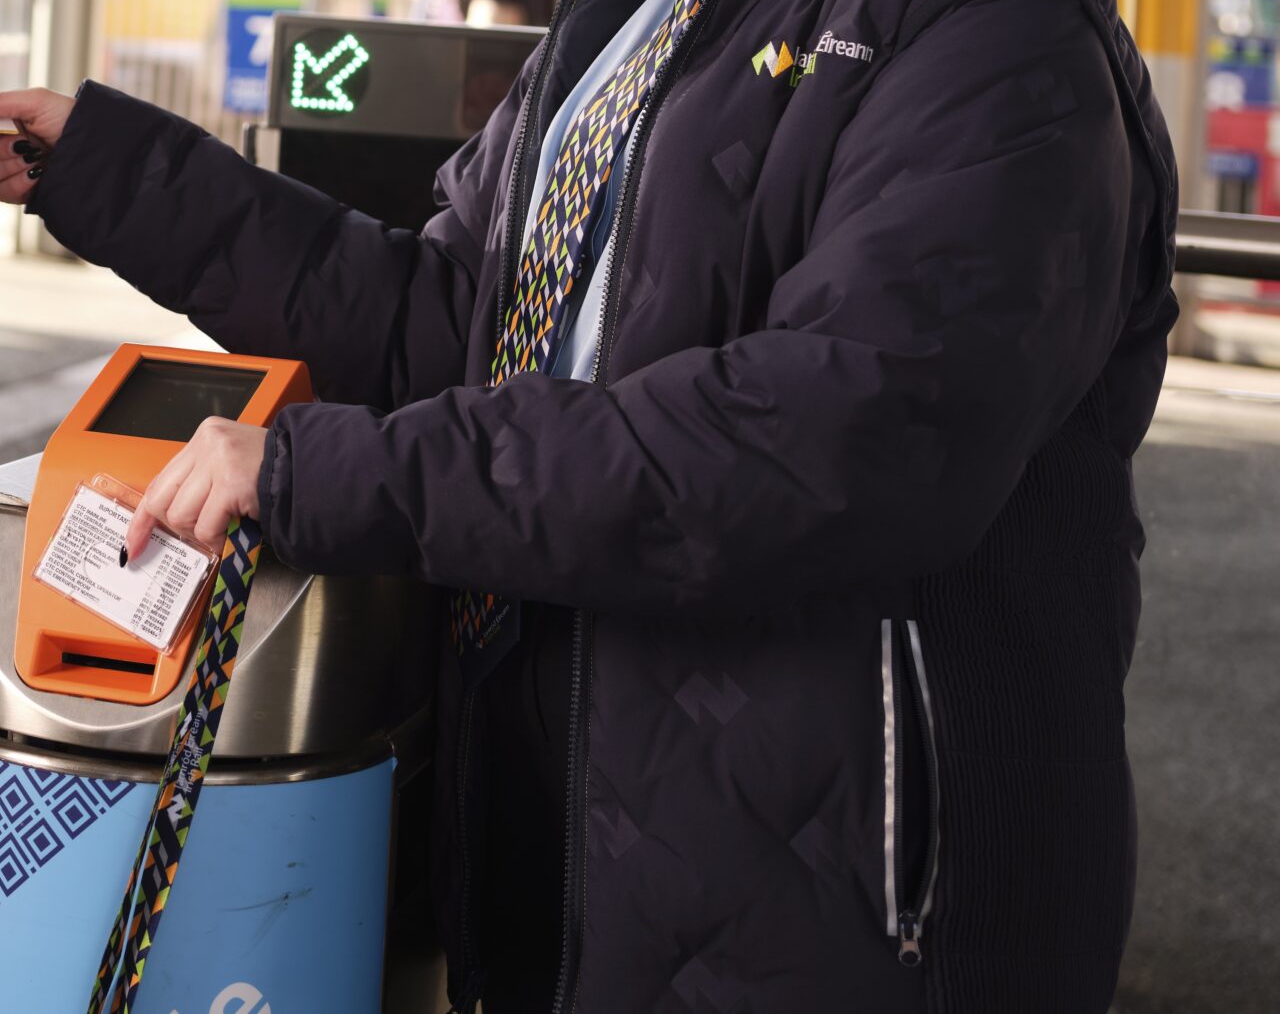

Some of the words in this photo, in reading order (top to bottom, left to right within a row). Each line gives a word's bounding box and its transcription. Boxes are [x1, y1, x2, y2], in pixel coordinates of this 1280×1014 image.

[816, 30, 875, 63] Éireann
[98, 504, 129, 525] IMPORTAN
[189, 746, 204, 768] Rail
[184, 768, 198, 792] Irish
